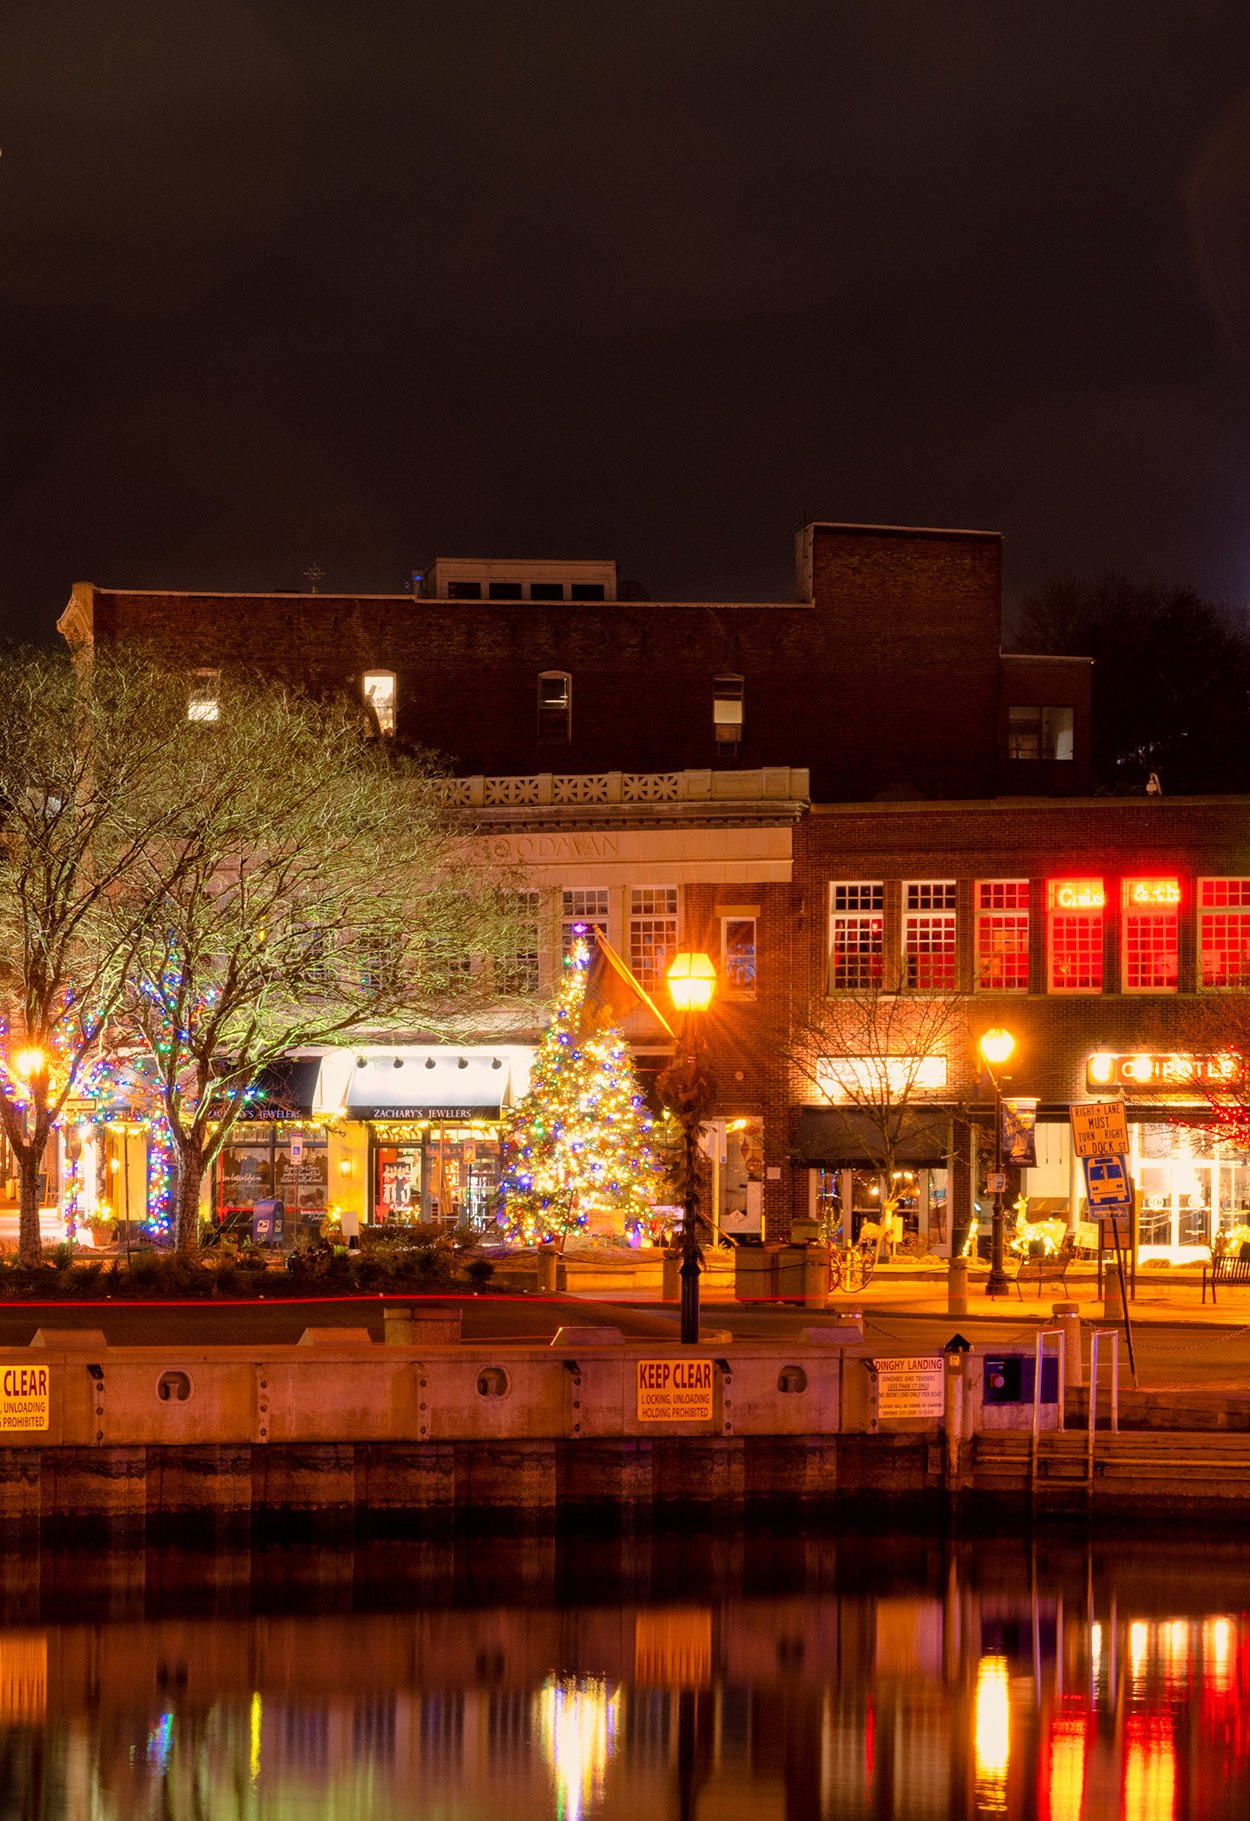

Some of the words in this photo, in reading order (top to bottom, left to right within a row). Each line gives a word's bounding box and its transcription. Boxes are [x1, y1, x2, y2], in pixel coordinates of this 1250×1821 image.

[1121, 1060, 1234, 1079] CIPOTLE
[259, 1109, 302, 1119] JEWELERS
[373, 1109, 423, 1118] ZACHARY'S
[428, 1109, 472, 1119] JEWELERS
[1074, 1106, 1095, 1117] RIGHT
[1103, 1104, 1121, 1115] LANE
[1088, 1116, 1110, 1129] MUST
[1078, 1131, 1096, 1142] TURN
[1105, 1129, 1124, 1139] RIGHT
[1079, 1144, 1087, 1154] AT
[1092, 1142, 1115, 1154] DOCK
[1118, 1141, 1126, 1152] ST
[875, 1360, 906, 1371] DINGHY
[907, 1359, 942, 1370] LANDING
[640, 1363, 670, 1389] KEEP
[673, 1363, 711, 1389] CLEAR
[4, 1370, 47, 1397] CLEAR
[4, 1401, 46, 1413] UNLOADING
[3, 1416, 45, 1427] PROHIBITED
